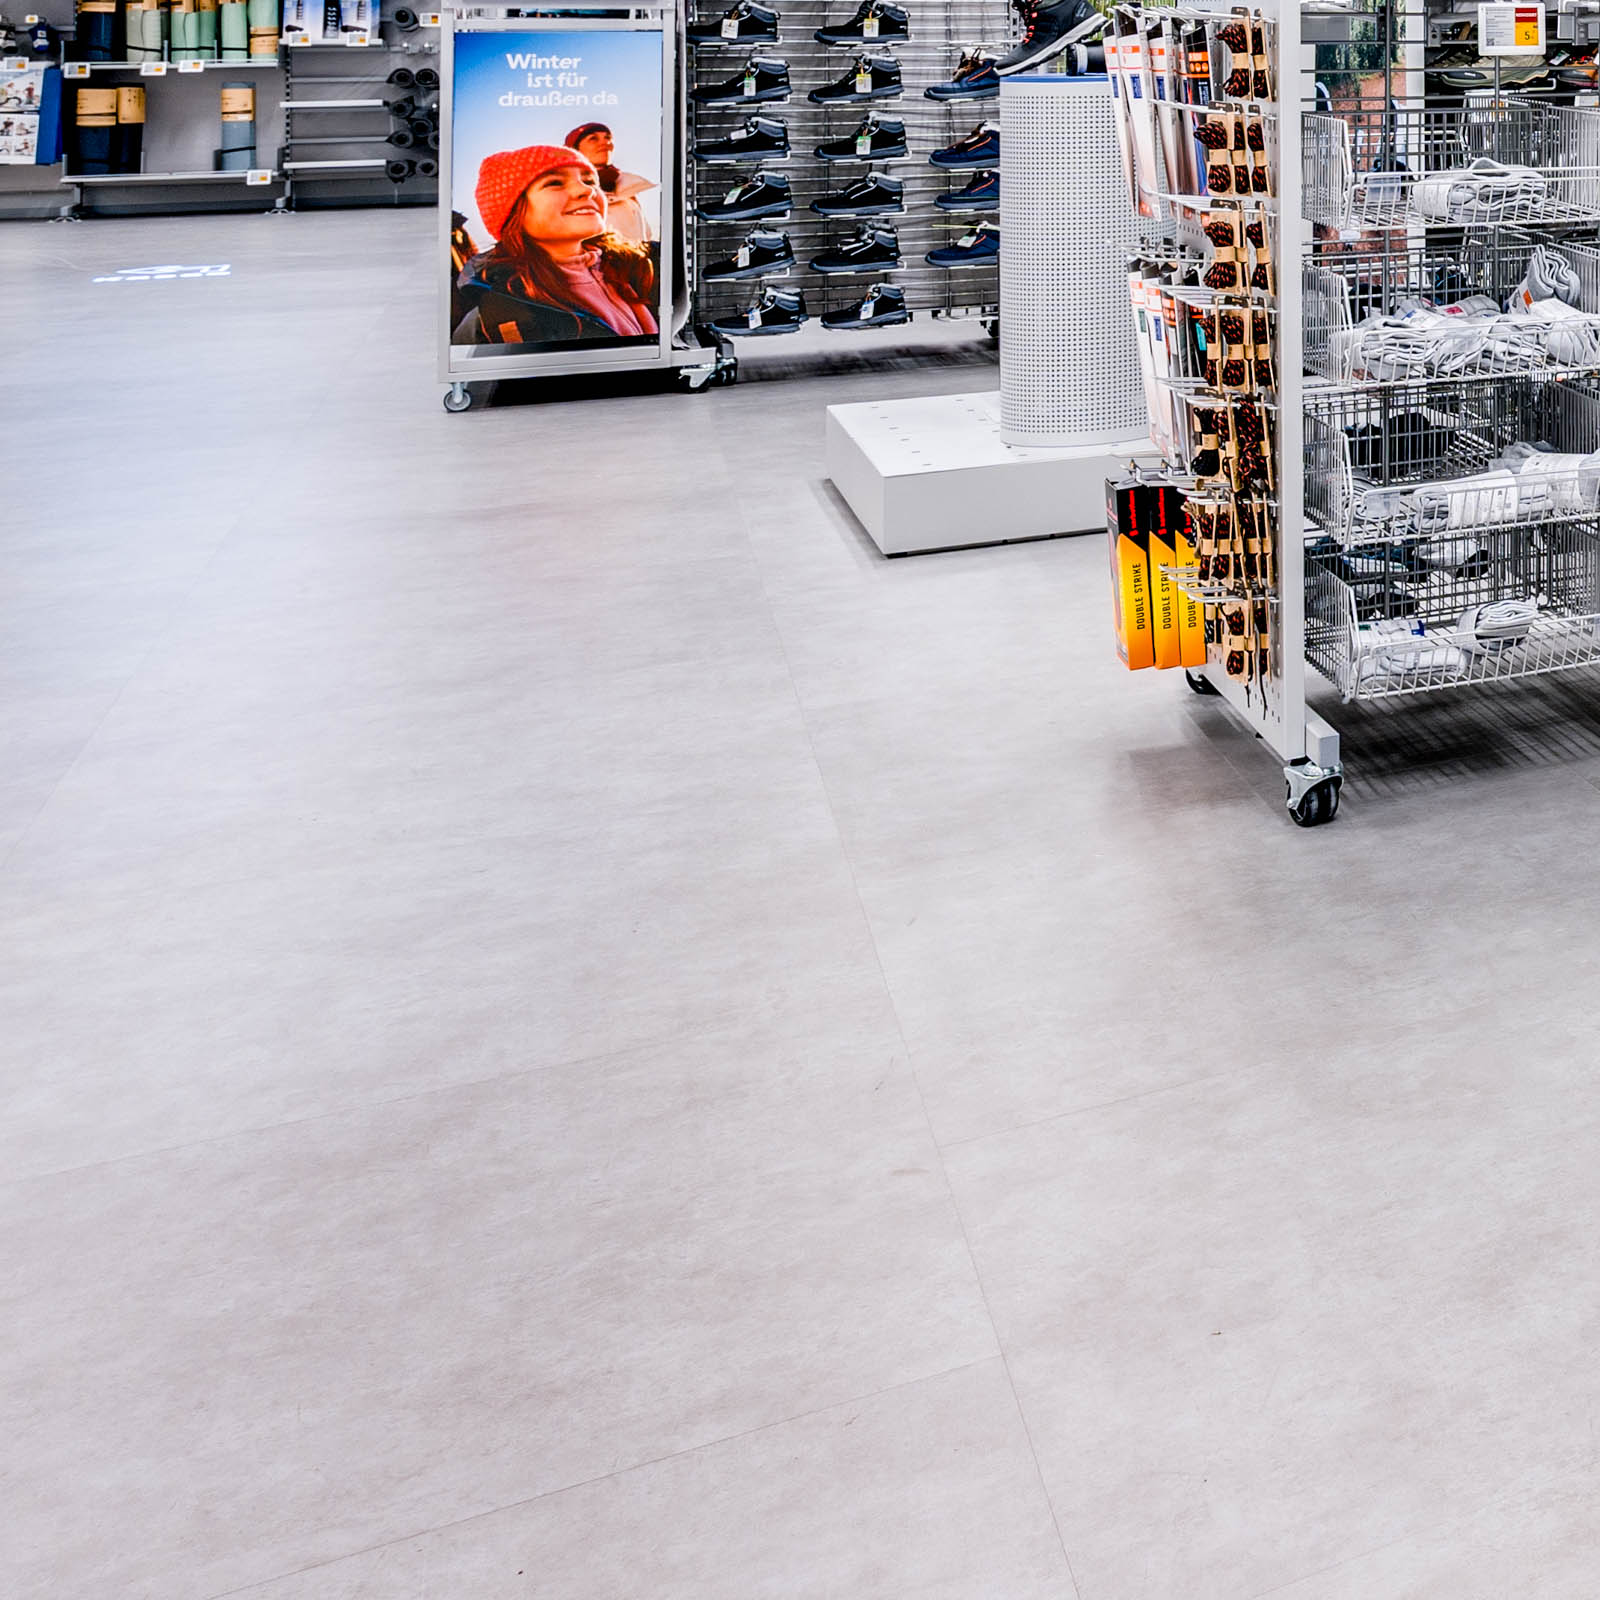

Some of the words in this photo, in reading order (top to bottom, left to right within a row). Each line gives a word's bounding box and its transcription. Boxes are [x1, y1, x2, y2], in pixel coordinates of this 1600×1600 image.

[1524, 32, 1530, 40] 5
[506, 53, 581, 70] Winter
[528, 72, 552, 88] ist
[557, 72, 588, 88] für
[498, 90, 588, 106] draußen
[592, 90, 618, 105] da
[1132, 562, 1142, 594] STRIKE
[1135, 596, 1146, 630] DOUBLE
[1160, 596, 1172, 630] DOUBLE
